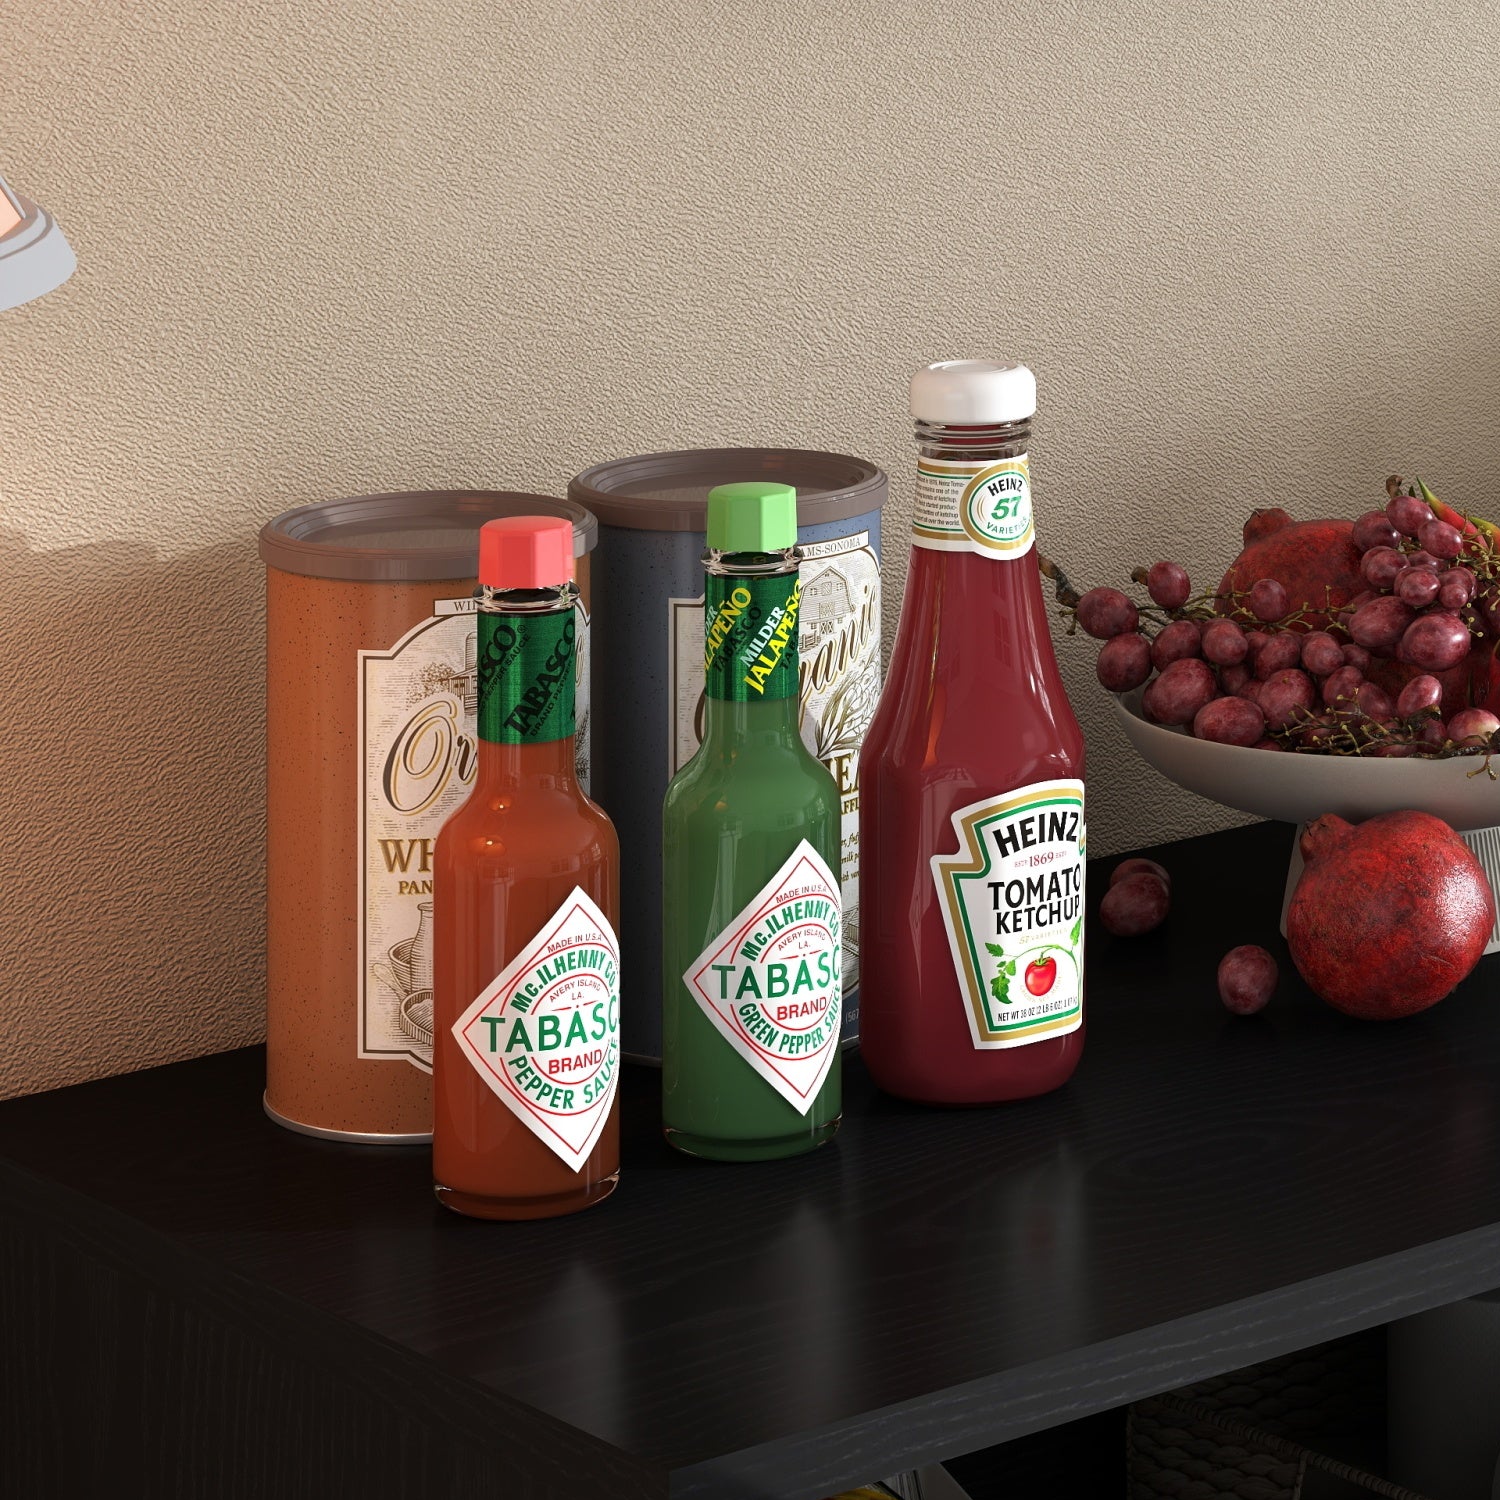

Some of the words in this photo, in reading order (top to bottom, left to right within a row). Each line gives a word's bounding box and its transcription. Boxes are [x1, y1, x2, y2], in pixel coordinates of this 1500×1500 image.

[987, 478, 1022, 496] HEINZ
[991, 496, 1021, 520] 57
[740, 606, 785, 669] MILDER
[503, 618, 575, 737] TABASCO
[992, 811, 1079, 858] HEINZ
[1029, 852, 1054, 867] 1869
[776, 890, 800, 904] MADE
[801, 885, 810, 893] IN
[987, 863, 1080, 910] TOMATO
[996, 894, 1079, 935] KETCHUP
[547, 937, 572, 954] MADE
[574, 934, 583, 943] IN
[778, 931, 802, 951] AVERY
[804, 928, 826, 941] ISLAND
[712, 944, 840, 1000] TABASC
[549, 981, 575, 1002] AVERY
[577, 979, 601, 991] ISLAND
[739, 1002, 779, 1048] GREEN
[779, 1029, 824, 1054] PEPPER
[824, 984, 841, 1033] SAUCE
[776, 996, 826, 1022] BRAND
[998, 1011, 1009, 1022] NET
[1011, 1010, 1020, 1020] WT
[480, 995, 619, 1053] TABASC
[508, 1055, 574, 1110] PEPPER
[583, 1037, 618, 1104] SAUCE
[548, 1049, 603, 1075] BRAND
